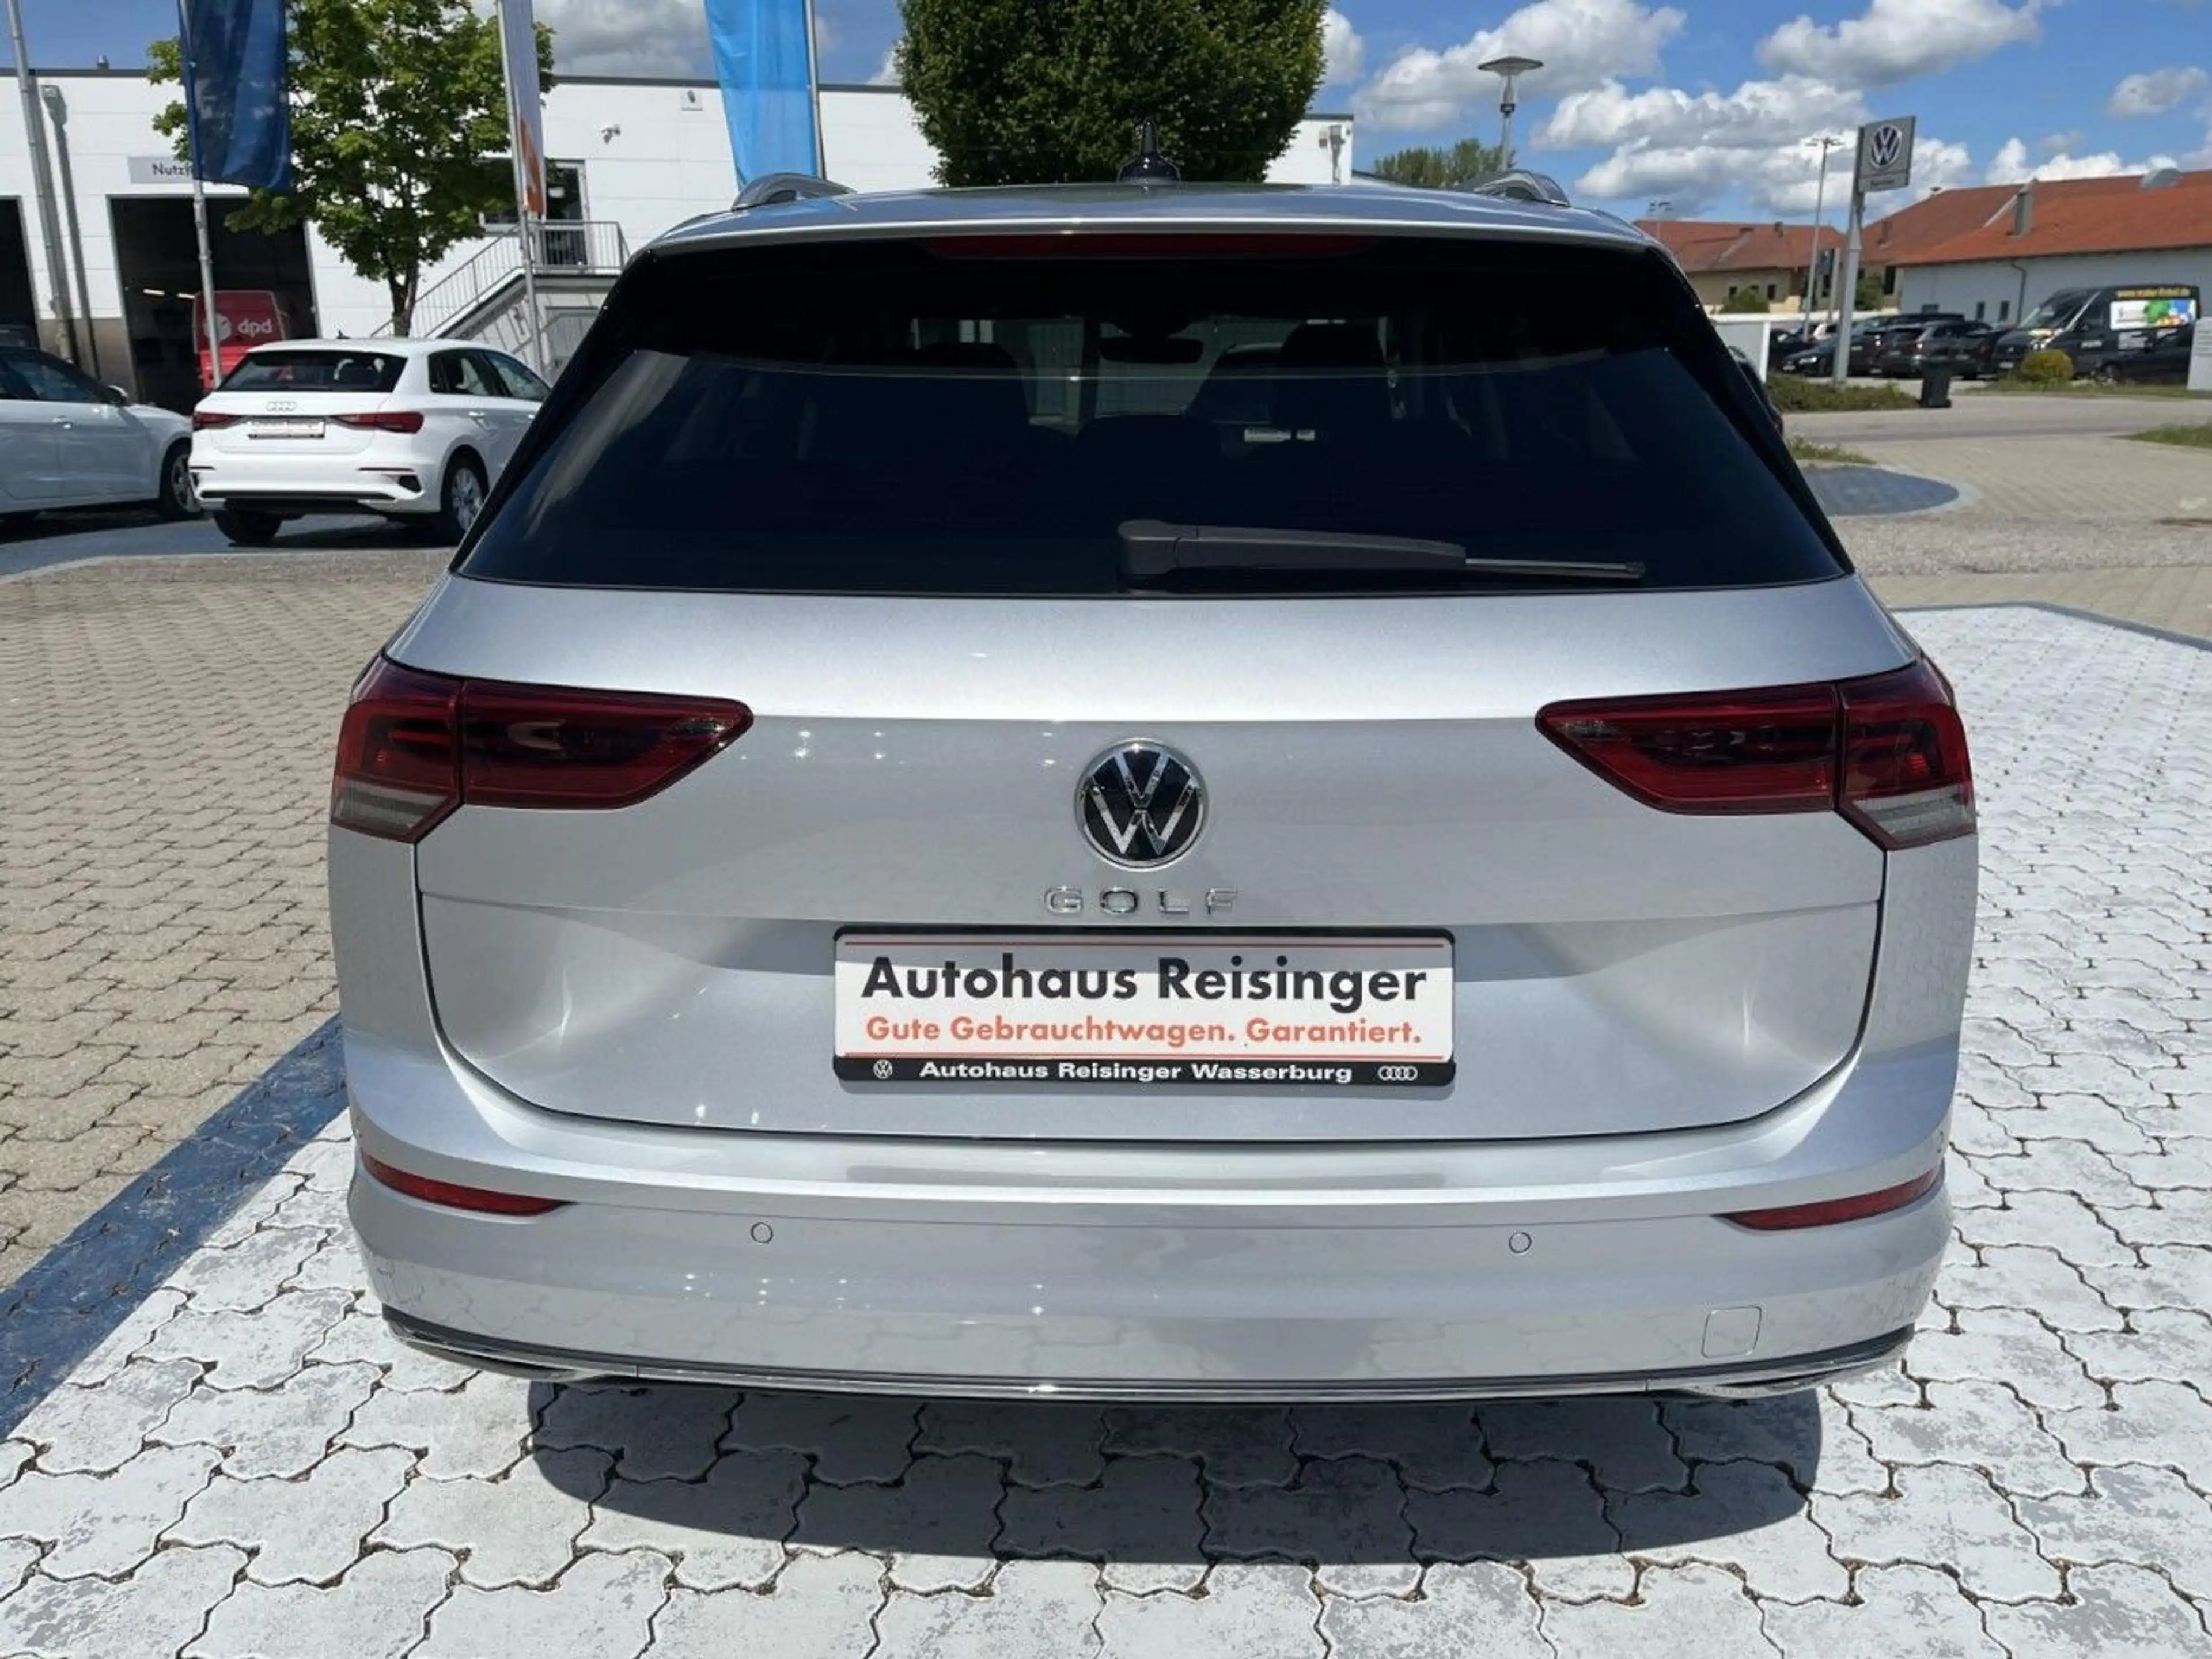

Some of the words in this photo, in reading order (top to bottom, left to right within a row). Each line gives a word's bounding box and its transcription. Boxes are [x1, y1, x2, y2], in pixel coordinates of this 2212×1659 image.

[237, 318, 272, 338] dpd
[1044, 886, 1238, 915] GOLF
[861, 953, 1138, 1000] Autohaus
[1158, 955, 1427, 1014] Reisinger
[866, 1016, 941, 1041] Gute
[950, 1015, 1236, 1048] Gebrauchtwagen.
[1245, 1017, 1422, 1044] Garantiert.
[919, 1061, 1049, 1079] Autohaus
[1058, 1062, 1182, 1083] Reisinger
[1191, 1063, 1353, 1083] Wasserburg
